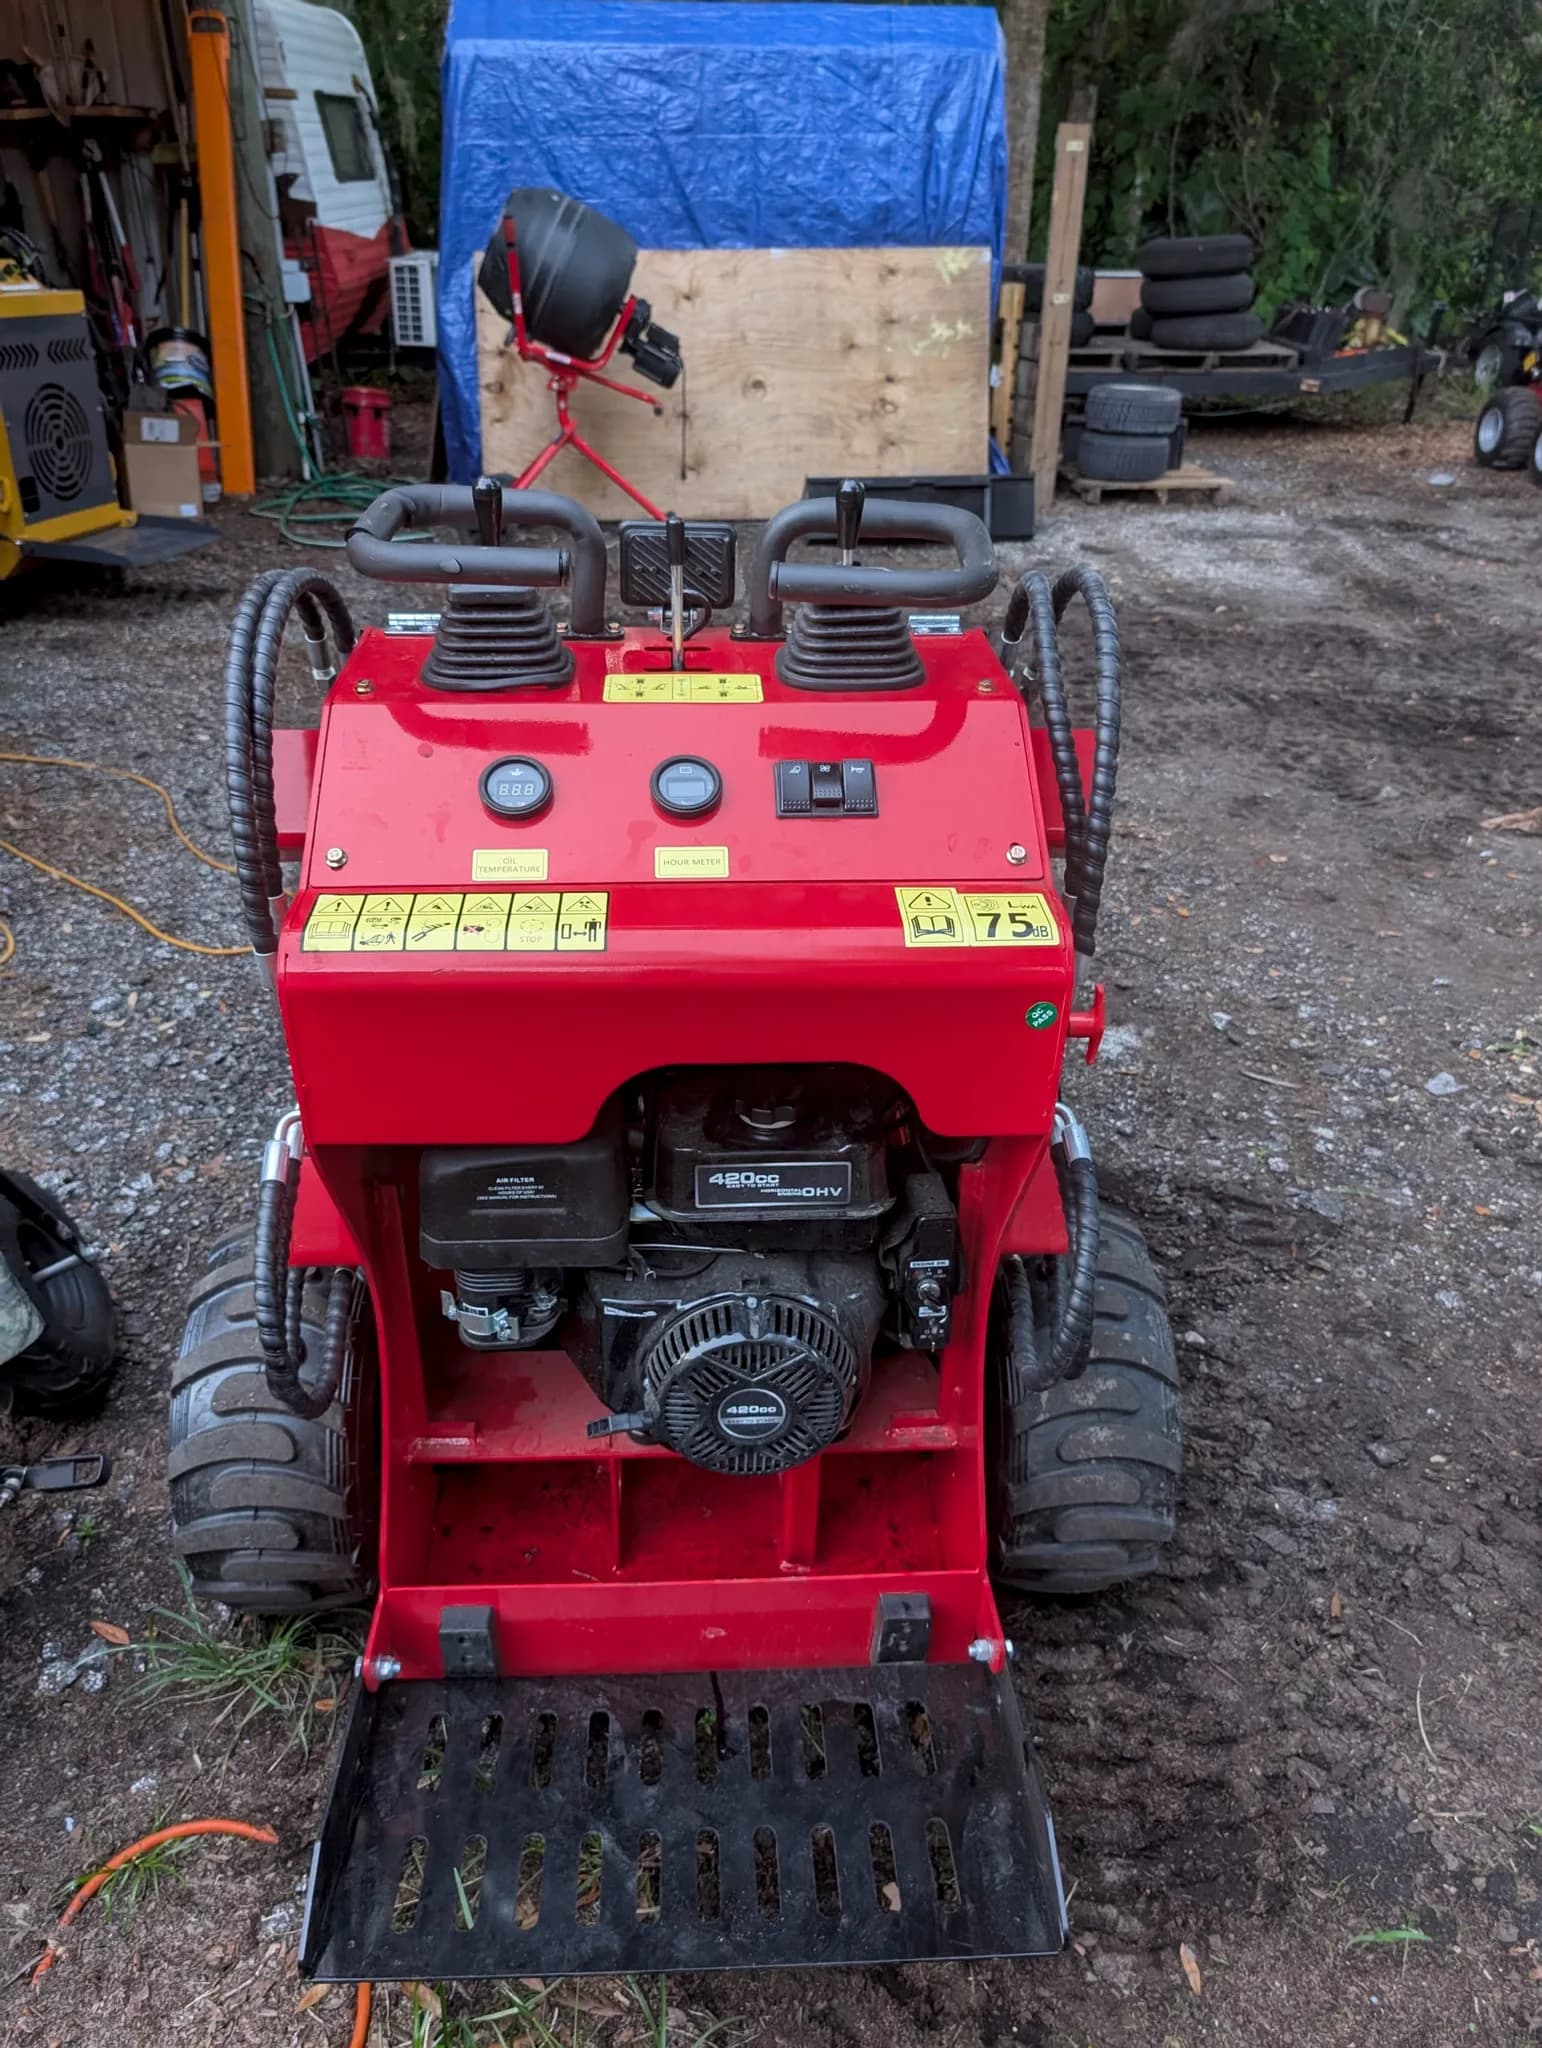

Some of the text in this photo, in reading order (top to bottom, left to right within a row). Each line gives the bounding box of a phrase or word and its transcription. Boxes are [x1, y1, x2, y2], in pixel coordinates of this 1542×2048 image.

[502, 857, 516, 865] OIL
[663, 858, 721, 866] HOUR METER
[479, 865, 541, 873] TEMPERATURE
[519, 935, 543, 944] STOP
[1031, 1007, 1044, 1019] QC
[1032, 1009, 1054, 1028] PASS
[709, 1171, 780, 1185] 420cc
[802, 1187, 843, 1197] OHV
[726, 1405, 777, 1414] 420cc
